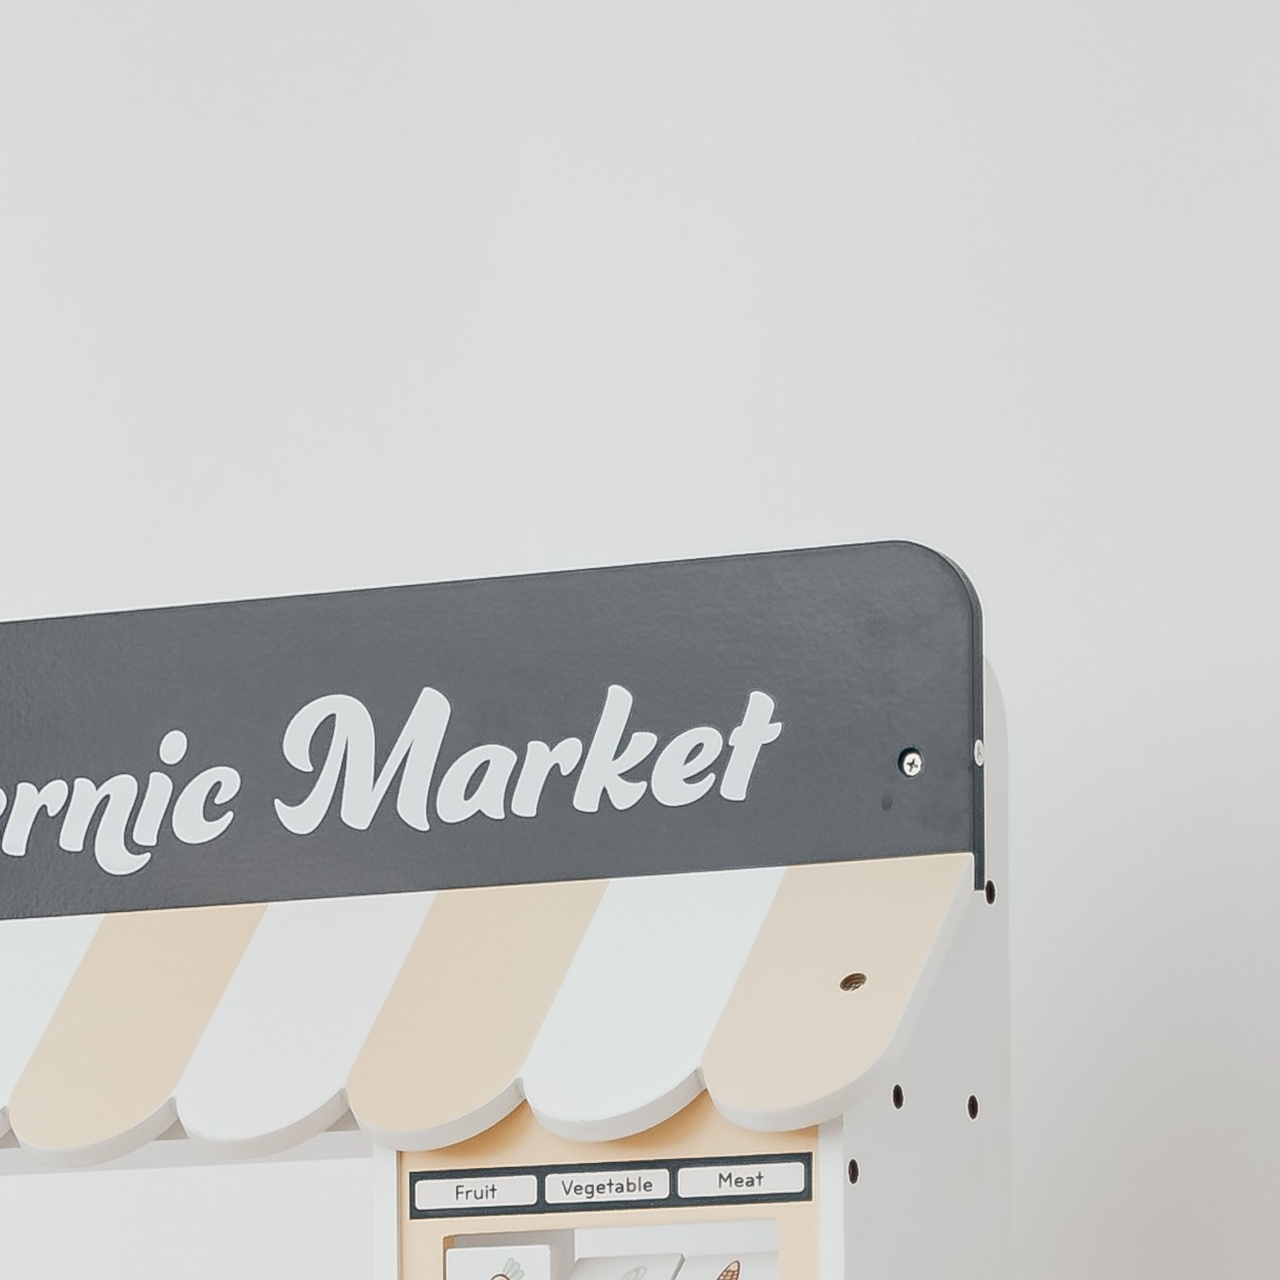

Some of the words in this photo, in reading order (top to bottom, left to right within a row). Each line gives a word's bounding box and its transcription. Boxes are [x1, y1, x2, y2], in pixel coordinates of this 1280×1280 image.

[274, 684, 784, 836] Market
[561, 1177, 654, 1200] Vegetable
[717, 1171, 765, 1189] Meat
[454, 1184, 498, 1201] Fruit
